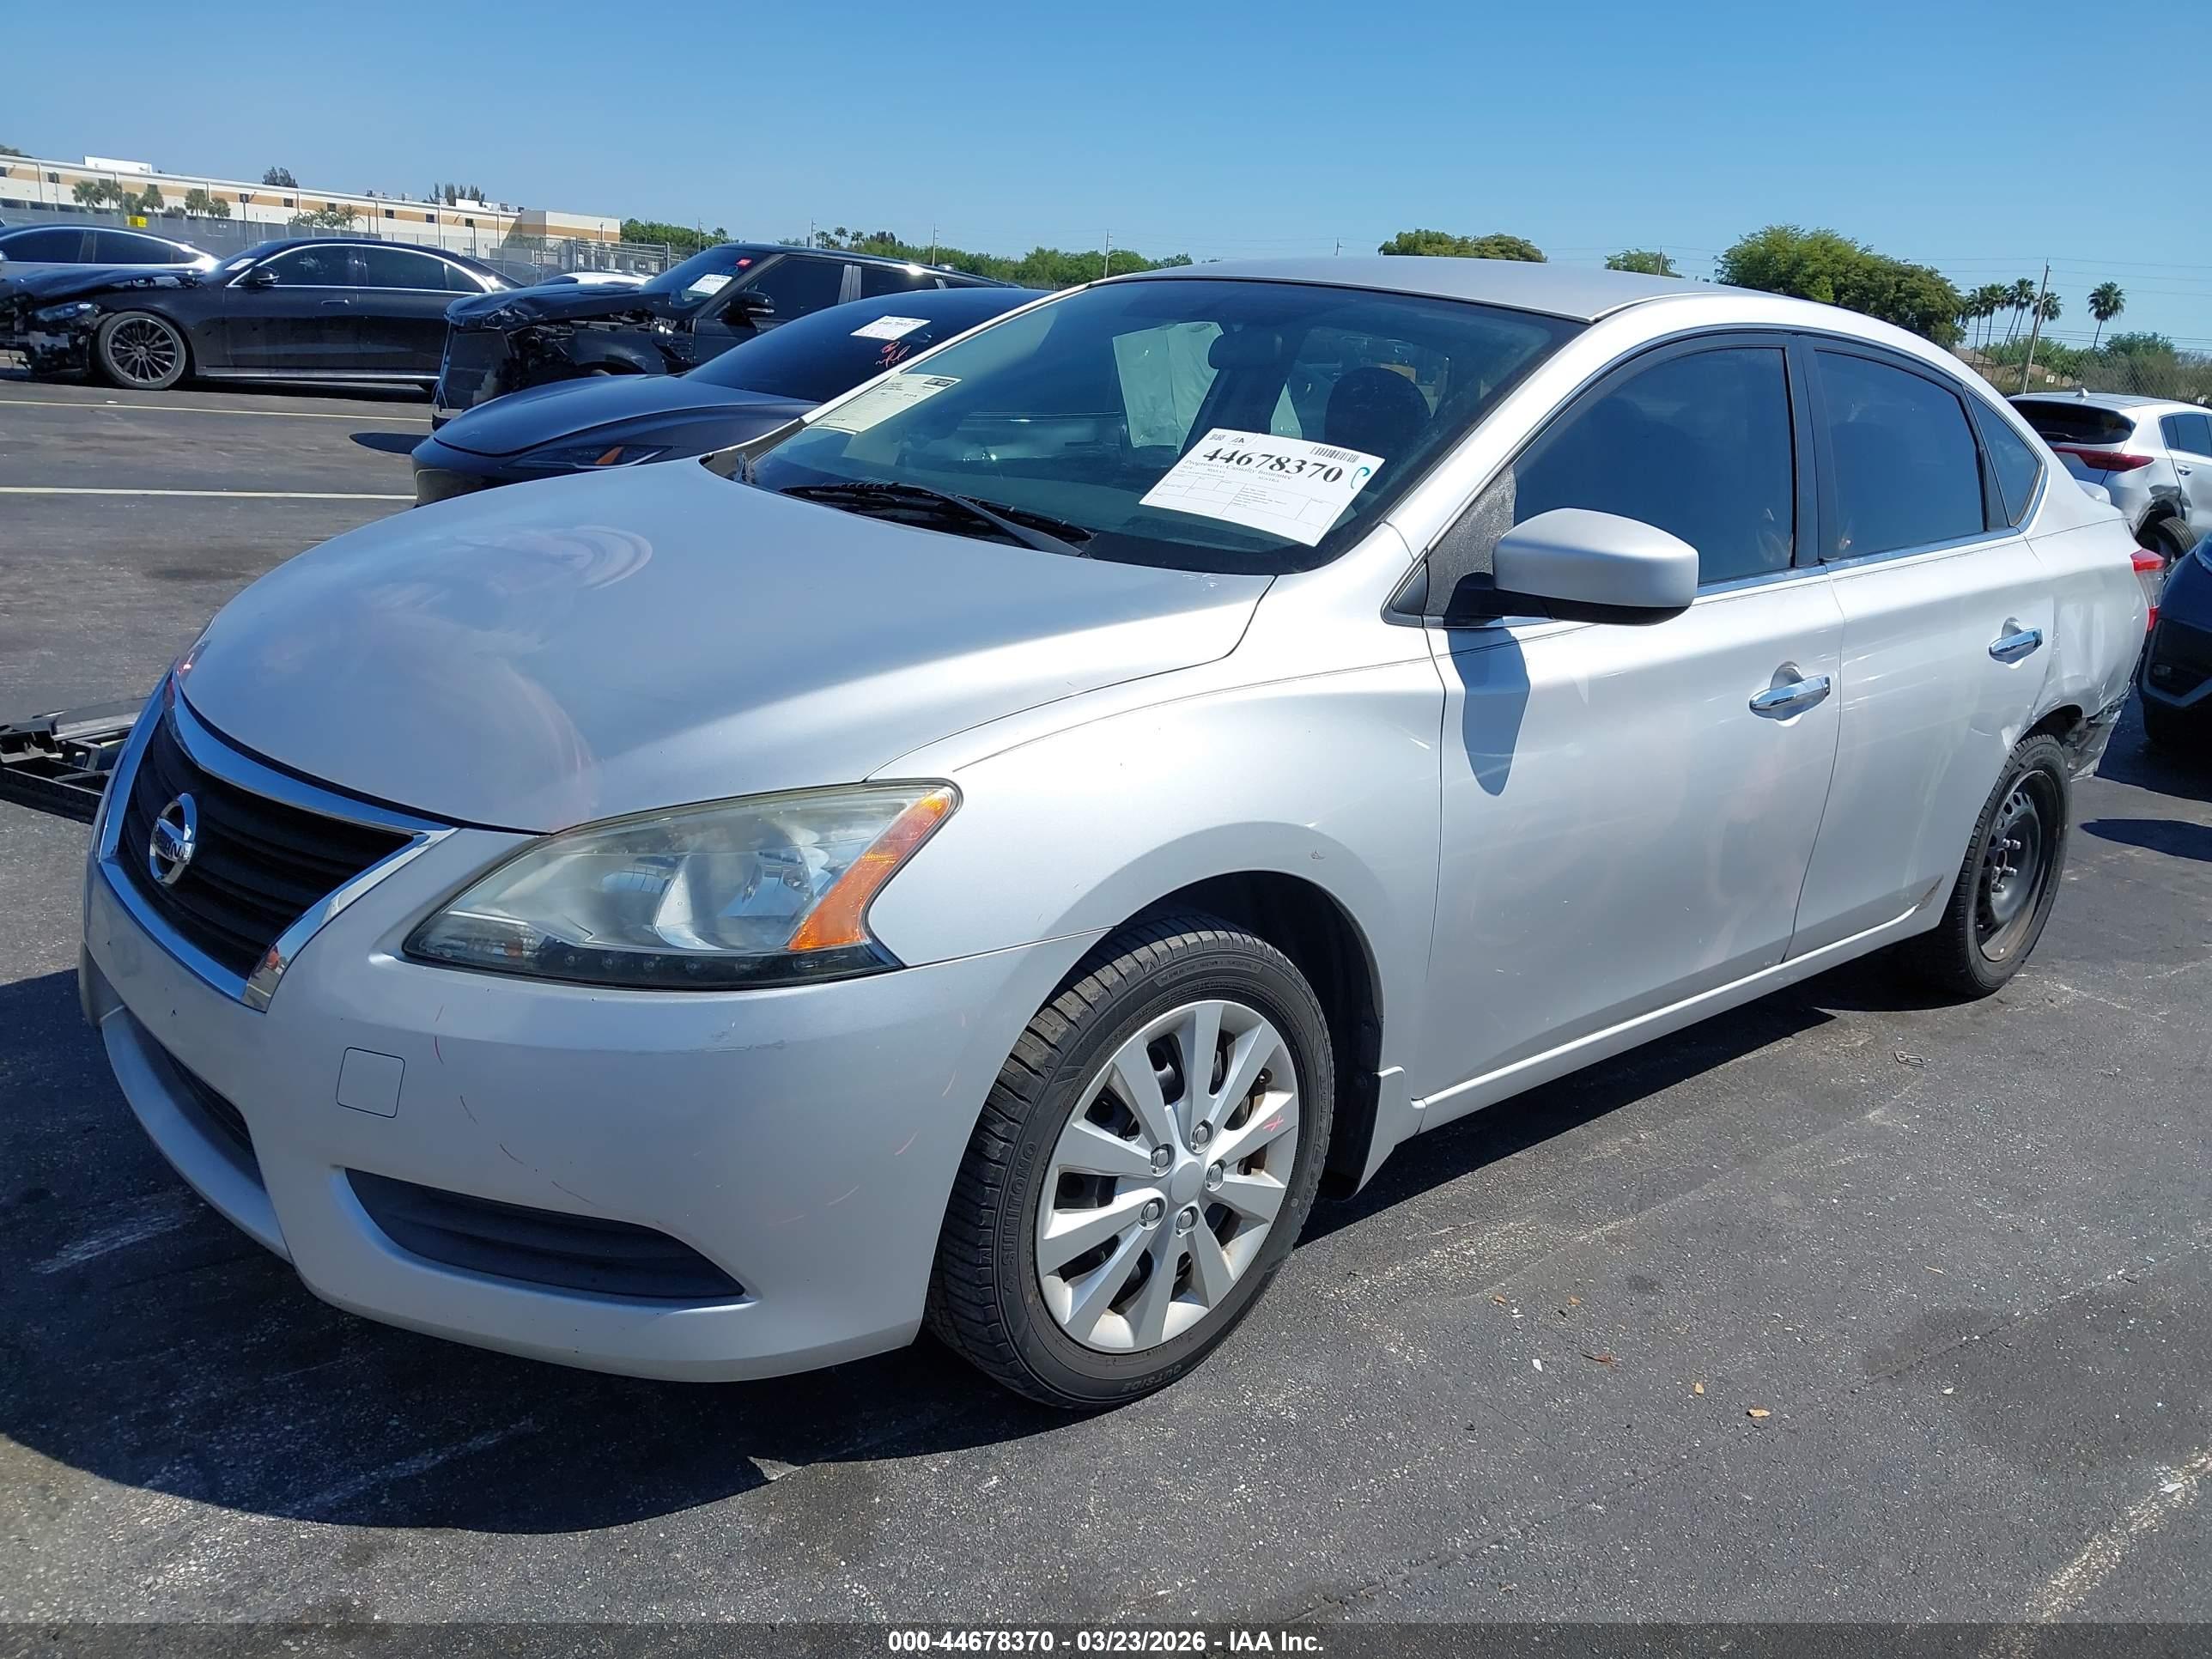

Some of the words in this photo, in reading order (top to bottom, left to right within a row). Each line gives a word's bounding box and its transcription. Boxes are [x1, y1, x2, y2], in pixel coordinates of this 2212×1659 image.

[1203, 447, 1343, 483] 44678370
[1001, 1141, 1036, 1266] SUMITOMO
[1121, 1364, 1182, 1393] OUTSIDE
